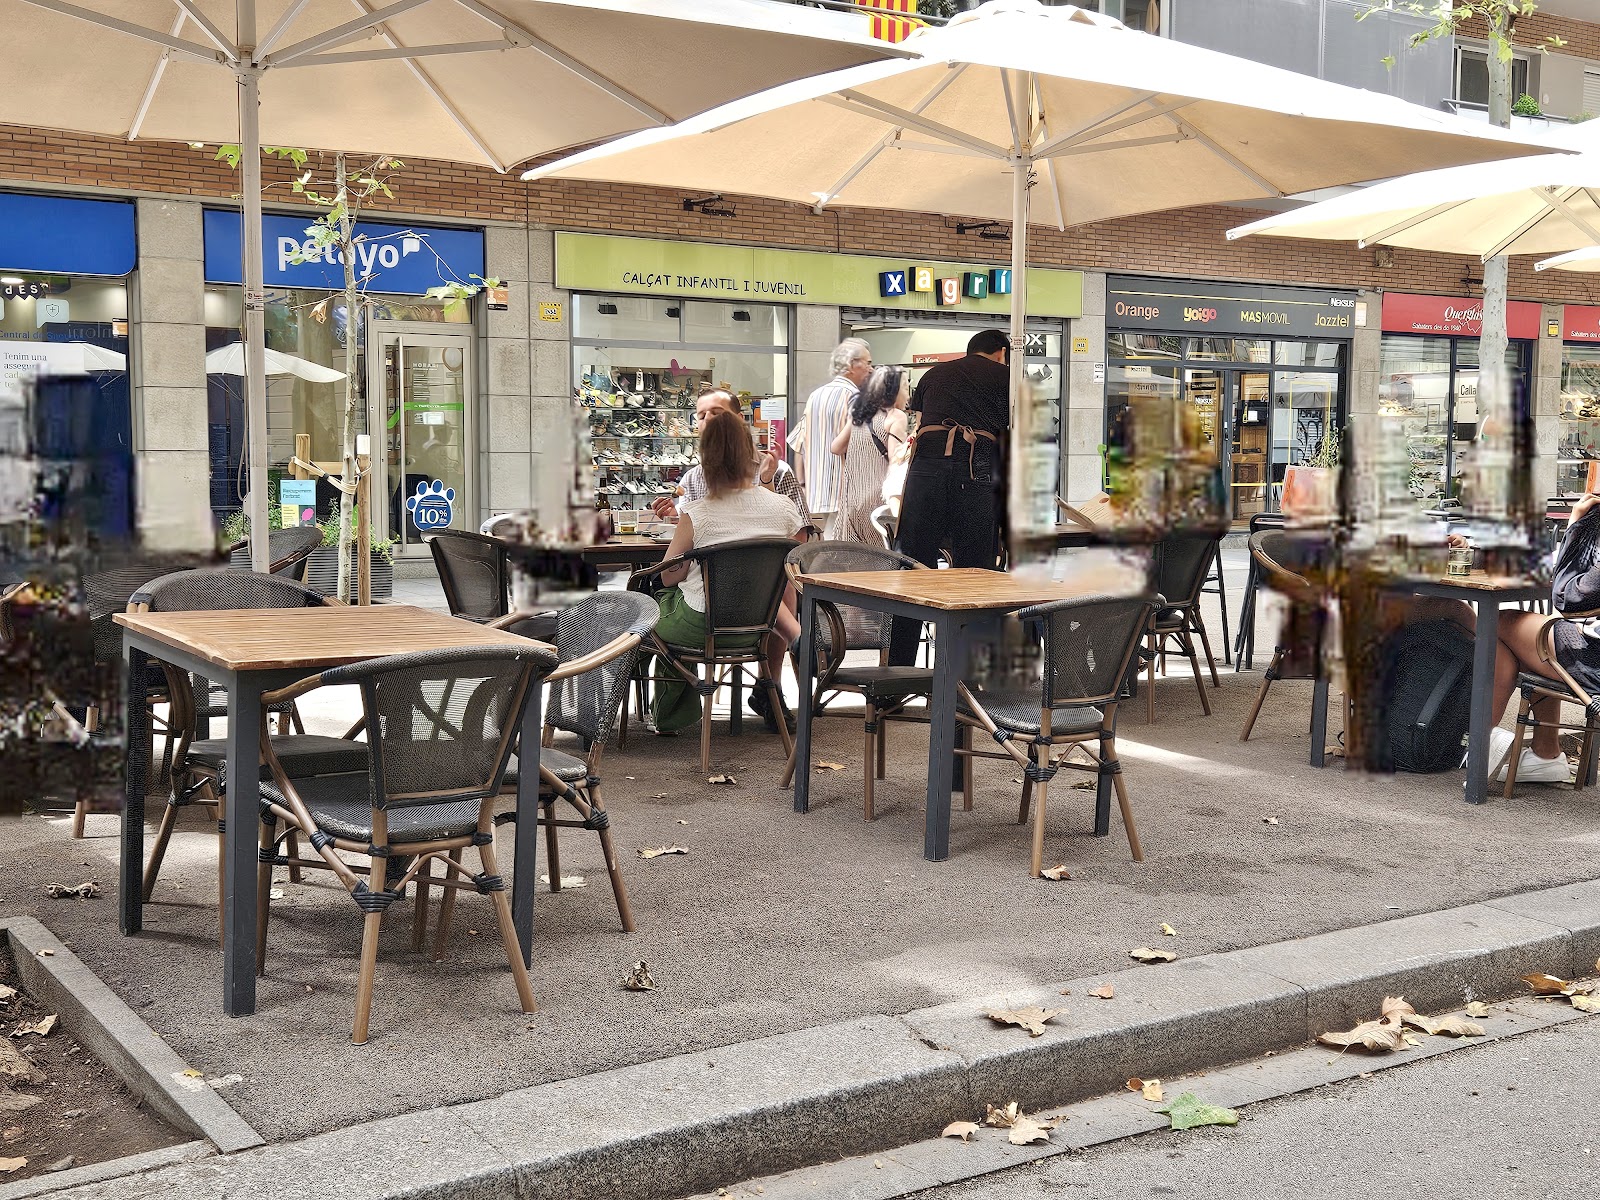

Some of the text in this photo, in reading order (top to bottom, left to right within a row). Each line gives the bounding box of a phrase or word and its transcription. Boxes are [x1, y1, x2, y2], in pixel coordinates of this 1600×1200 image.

[623, 272, 807, 296] CALÇAT INFANTIL I JUVENIL
[887, 270, 1008, 304] xagrí
[1115, 301, 1350, 327] Orange yoigo MASMOVIL Jazztel
[4, 352, 29, 361] Tenim
